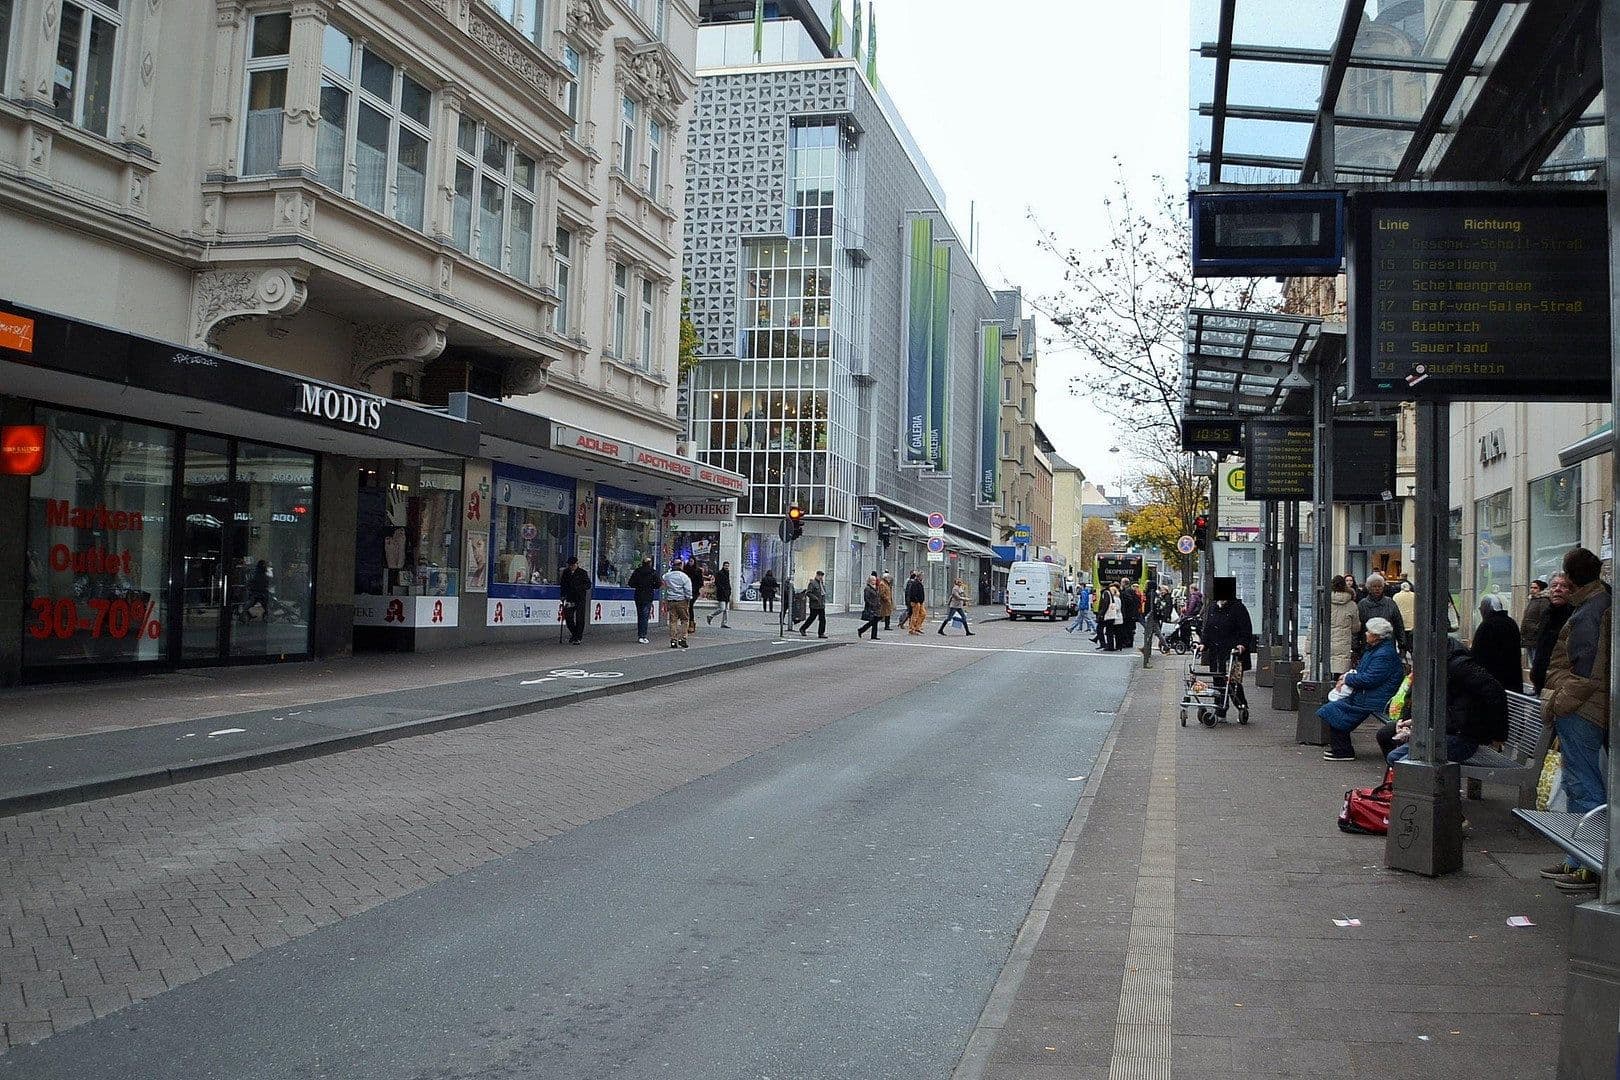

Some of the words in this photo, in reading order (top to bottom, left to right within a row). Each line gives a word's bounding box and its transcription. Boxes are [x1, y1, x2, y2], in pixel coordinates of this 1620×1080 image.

[1378, 219, 1410, 231] Linie
[1464, 219, 1521, 232] Richtung
[1411, 280, 1532, 293] Schelmengraben
[1411, 301, 1584, 312] Graf-von-Galen-Straß
[1378, 321, 1395, 332] 45
[1411, 321, 1481, 332] Biebrich
[1379, 342, 1395, 353] 18
[1411, 342, 1488, 353] Sauerland
[912, 414, 922, 448] GALERIA
[576, 435, 619, 457] ADLER
[637, 452, 692, 476] APOTHEKE
[985, 469, 993, 494] GALERIA
[46, 498, 144, 531] Marken
[49, 543, 132, 576] Outlet
[29, 596, 161, 640] 30-70%
